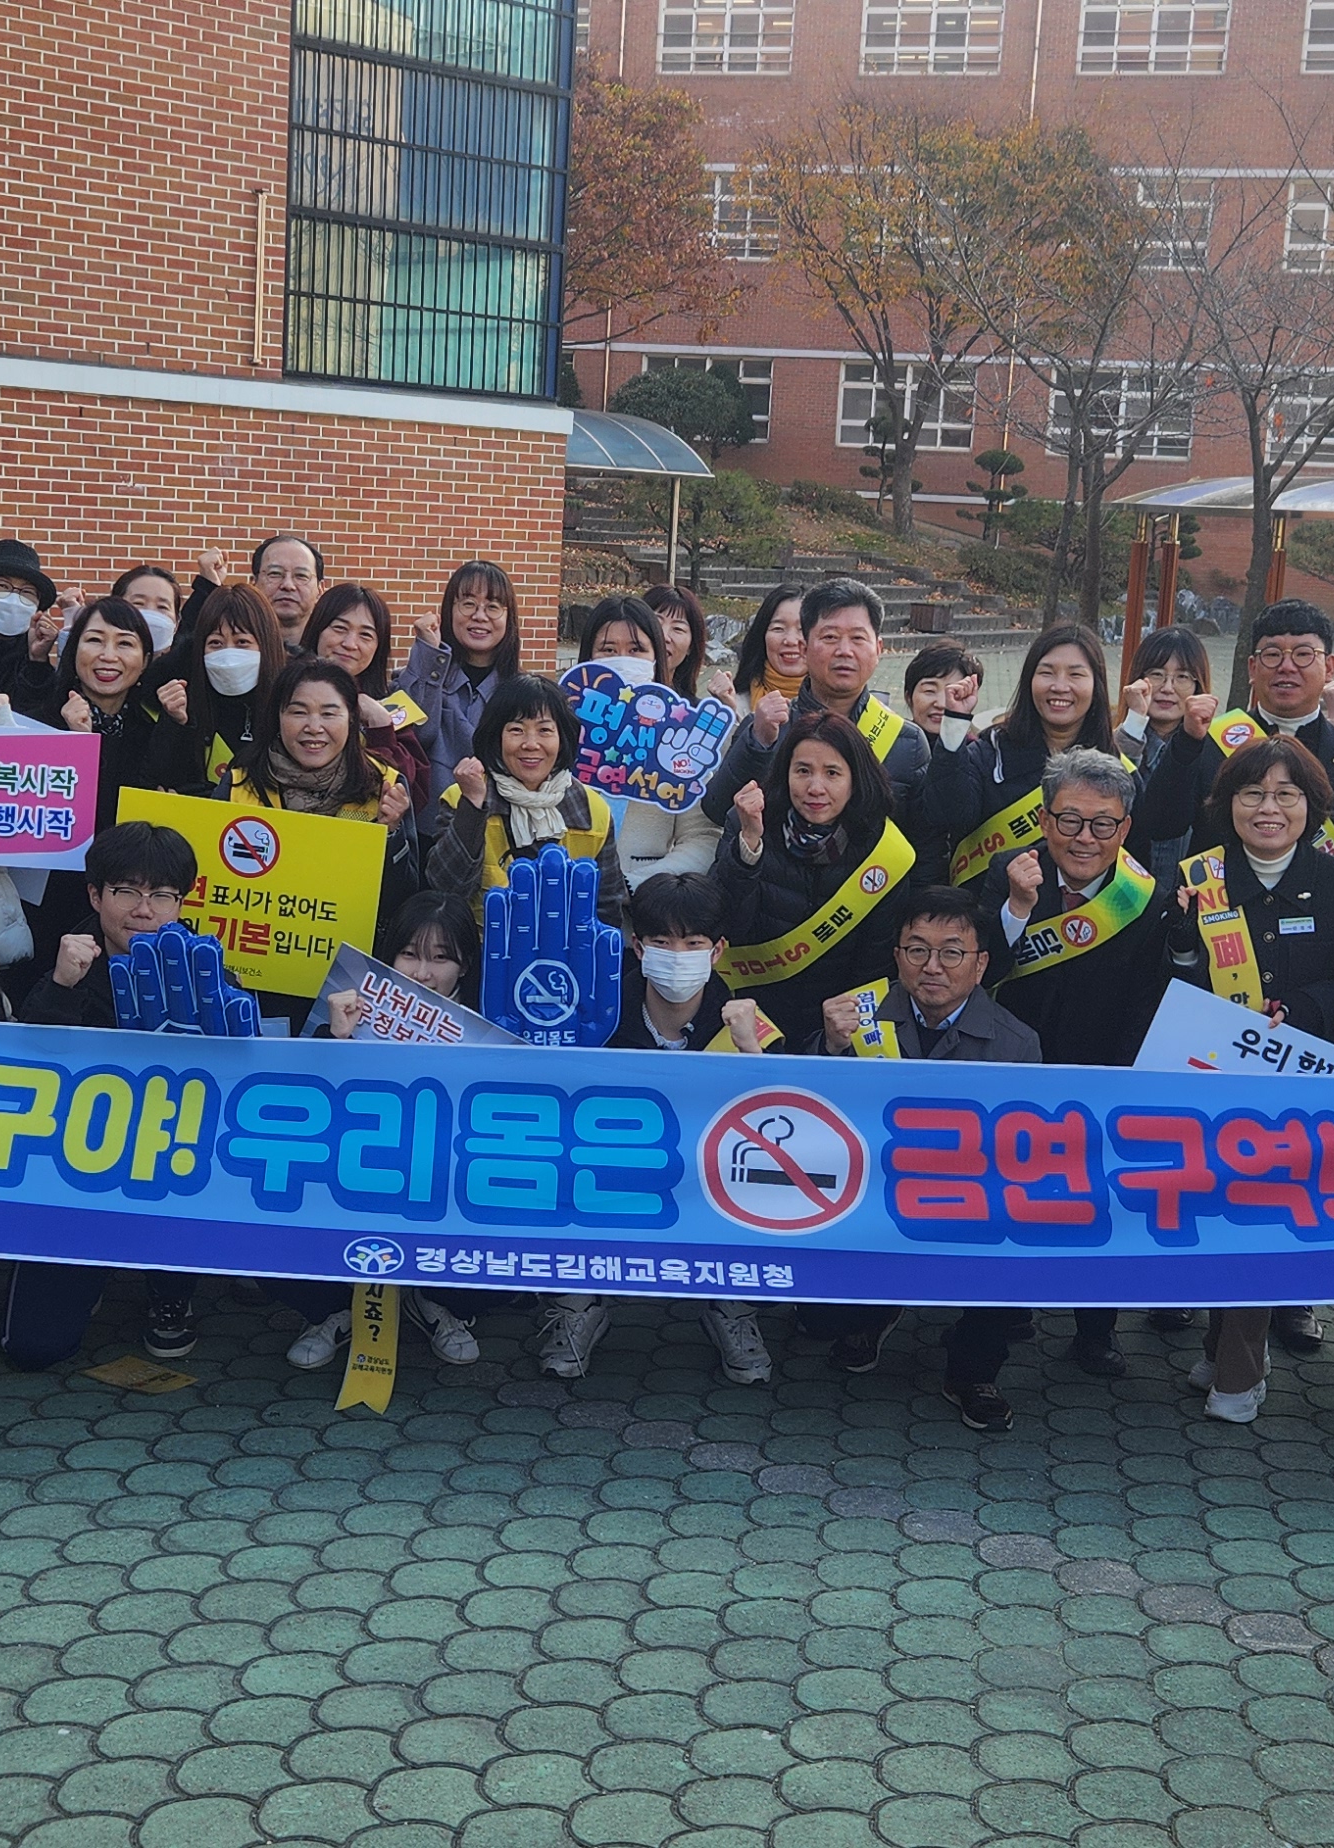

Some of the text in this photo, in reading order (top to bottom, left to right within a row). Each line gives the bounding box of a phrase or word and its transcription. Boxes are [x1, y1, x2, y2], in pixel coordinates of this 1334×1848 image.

[575, 687, 656, 761] 평생
[576, 748, 685, 809] 금연선언
[208, 885, 273, 915] 표시가
[277, 893, 338, 922] 없어도
[811, 904, 854, 944] 담배
[1202, 909, 1240, 925] SMOKING
[361, 973, 463, 1043] 나눠피는
[857, 990, 883, 1046] 엄마아빠
[1232, 1028, 1293, 1073] 우리
[228, 1083, 432, 1202] 우리
[465, 1094, 669, 1216] 몸은
[891, 1106, 1096, 1224] 금연
[416, 1245, 796, 1289] 경상남도김해교육지원청
